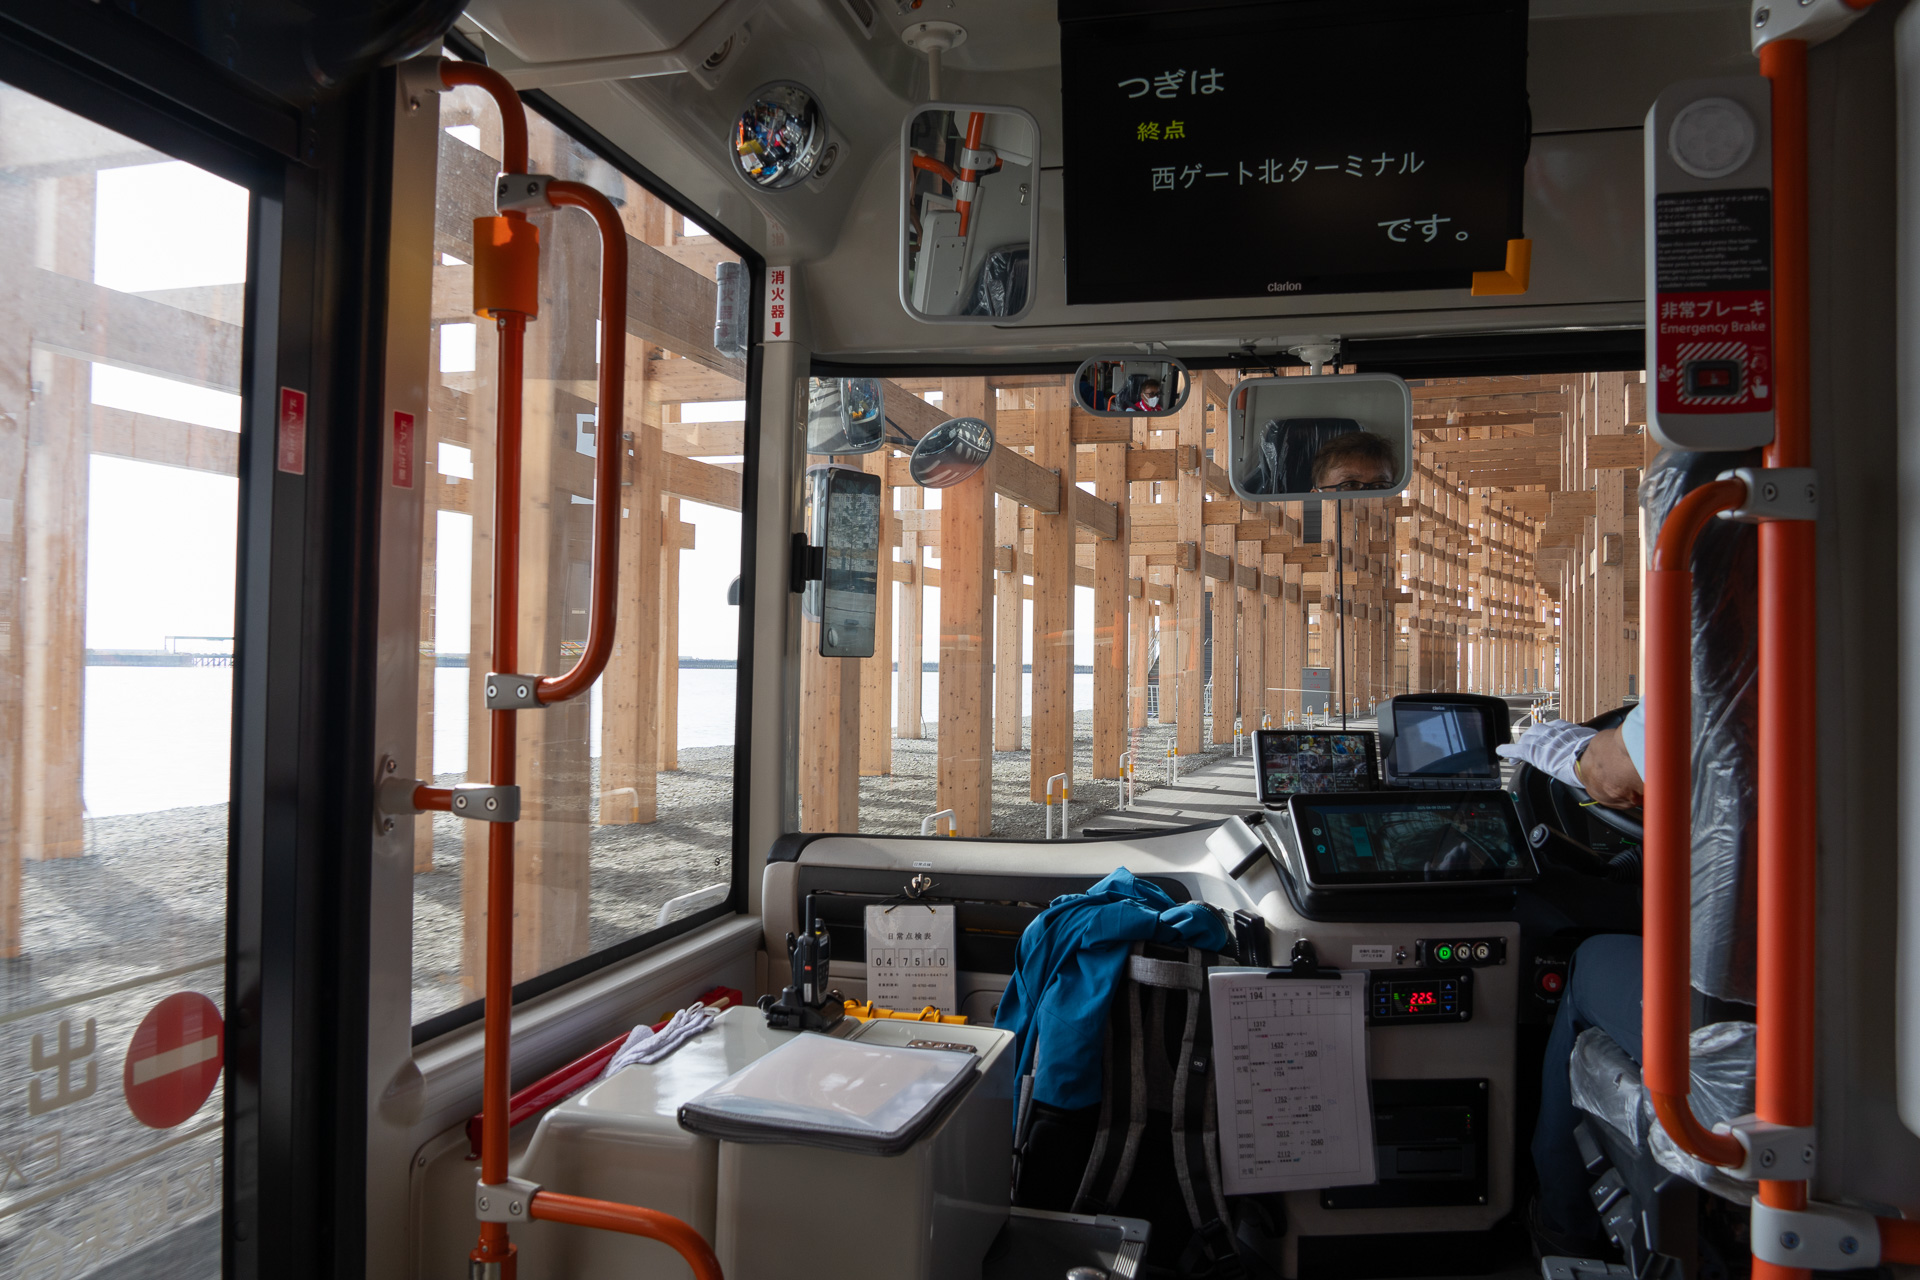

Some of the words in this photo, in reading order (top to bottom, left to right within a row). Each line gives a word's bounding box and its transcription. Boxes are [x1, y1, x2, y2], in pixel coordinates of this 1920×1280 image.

[1118, 68, 1224, 98] つぎは
[1137, 120, 1185, 141] 終点
[1151, 152, 1425, 191] 西ゲート北ターミナル
[1377, 213, 1468, 243] です。
[771, 270, 784, 318] 消火器
[1268, 282, 1302, 292] clarion
[1661, 300, 1765, 319] 非常ブレーキ
[1660, 324, 1728, 336] Emergency
[1732, 321, 1766, 332] Brake
[888, 932, 932, 940] 日常点検表
